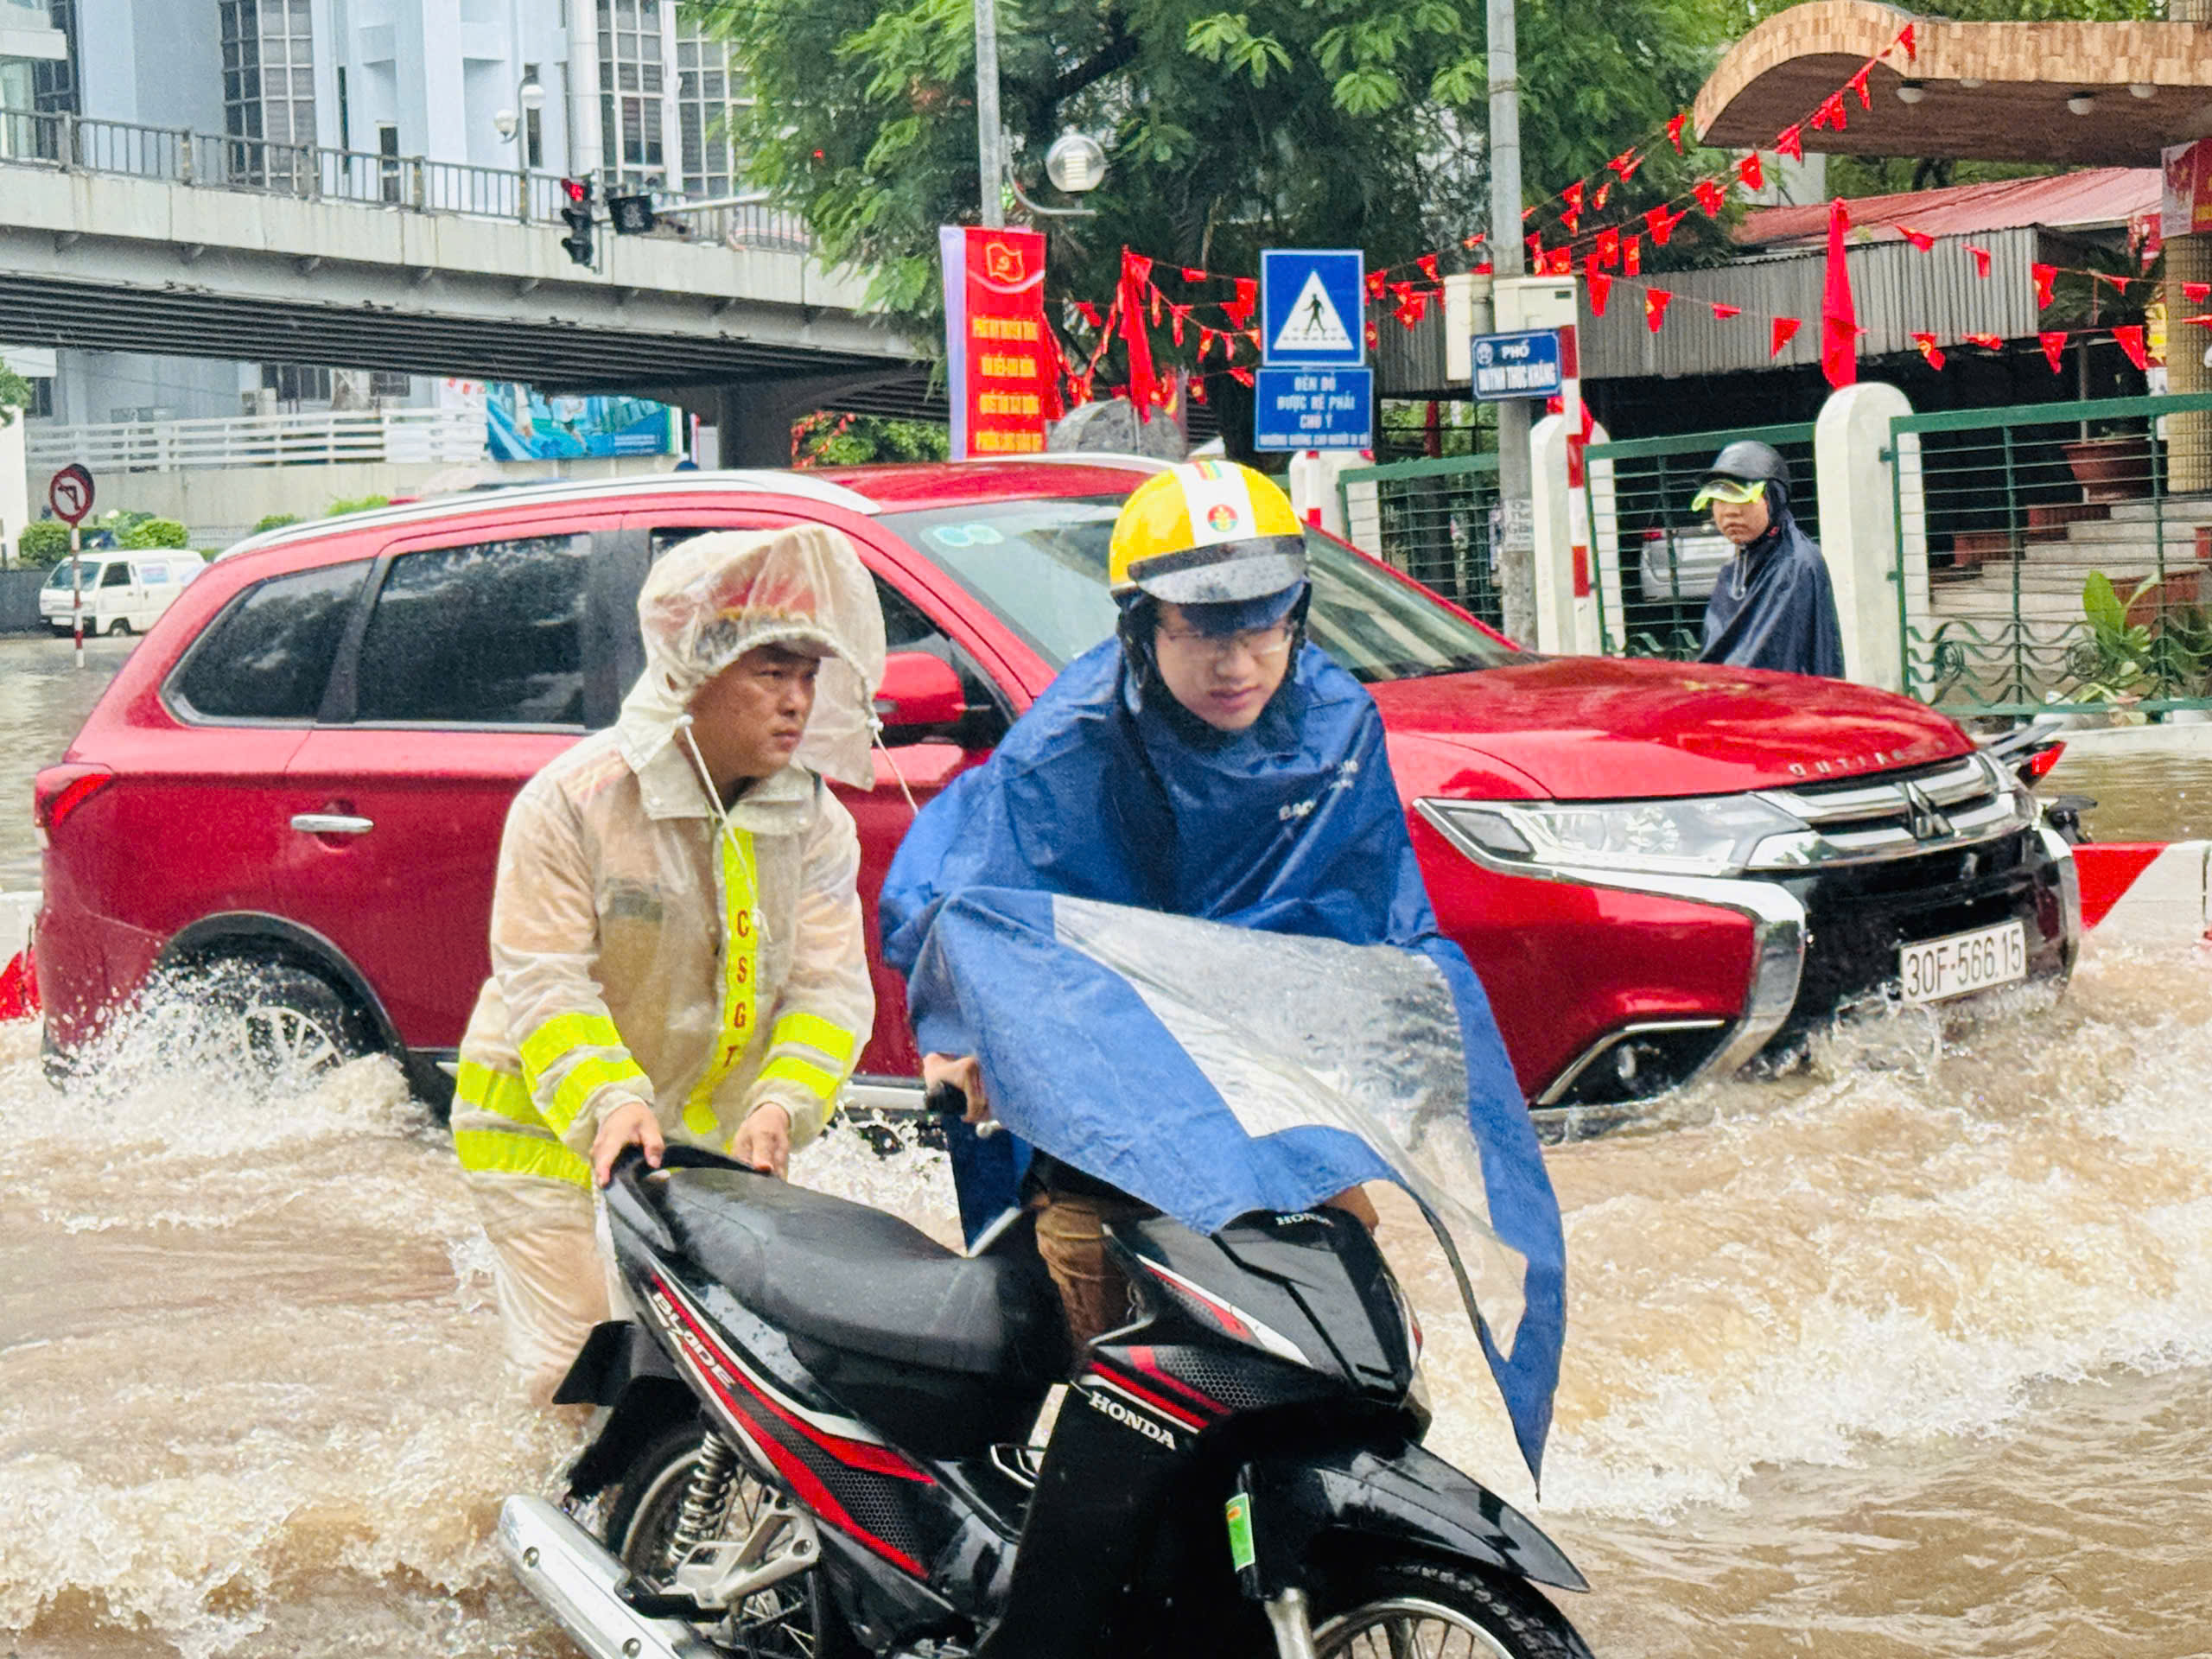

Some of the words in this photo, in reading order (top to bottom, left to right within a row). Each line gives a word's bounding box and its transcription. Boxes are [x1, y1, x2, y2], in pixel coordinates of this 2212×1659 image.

[1501, 339, 1530, 360] PHỐ
[652, 1291, 736, 1390] BLADE
[1088, 1389, 1178, 1452] HONDA
